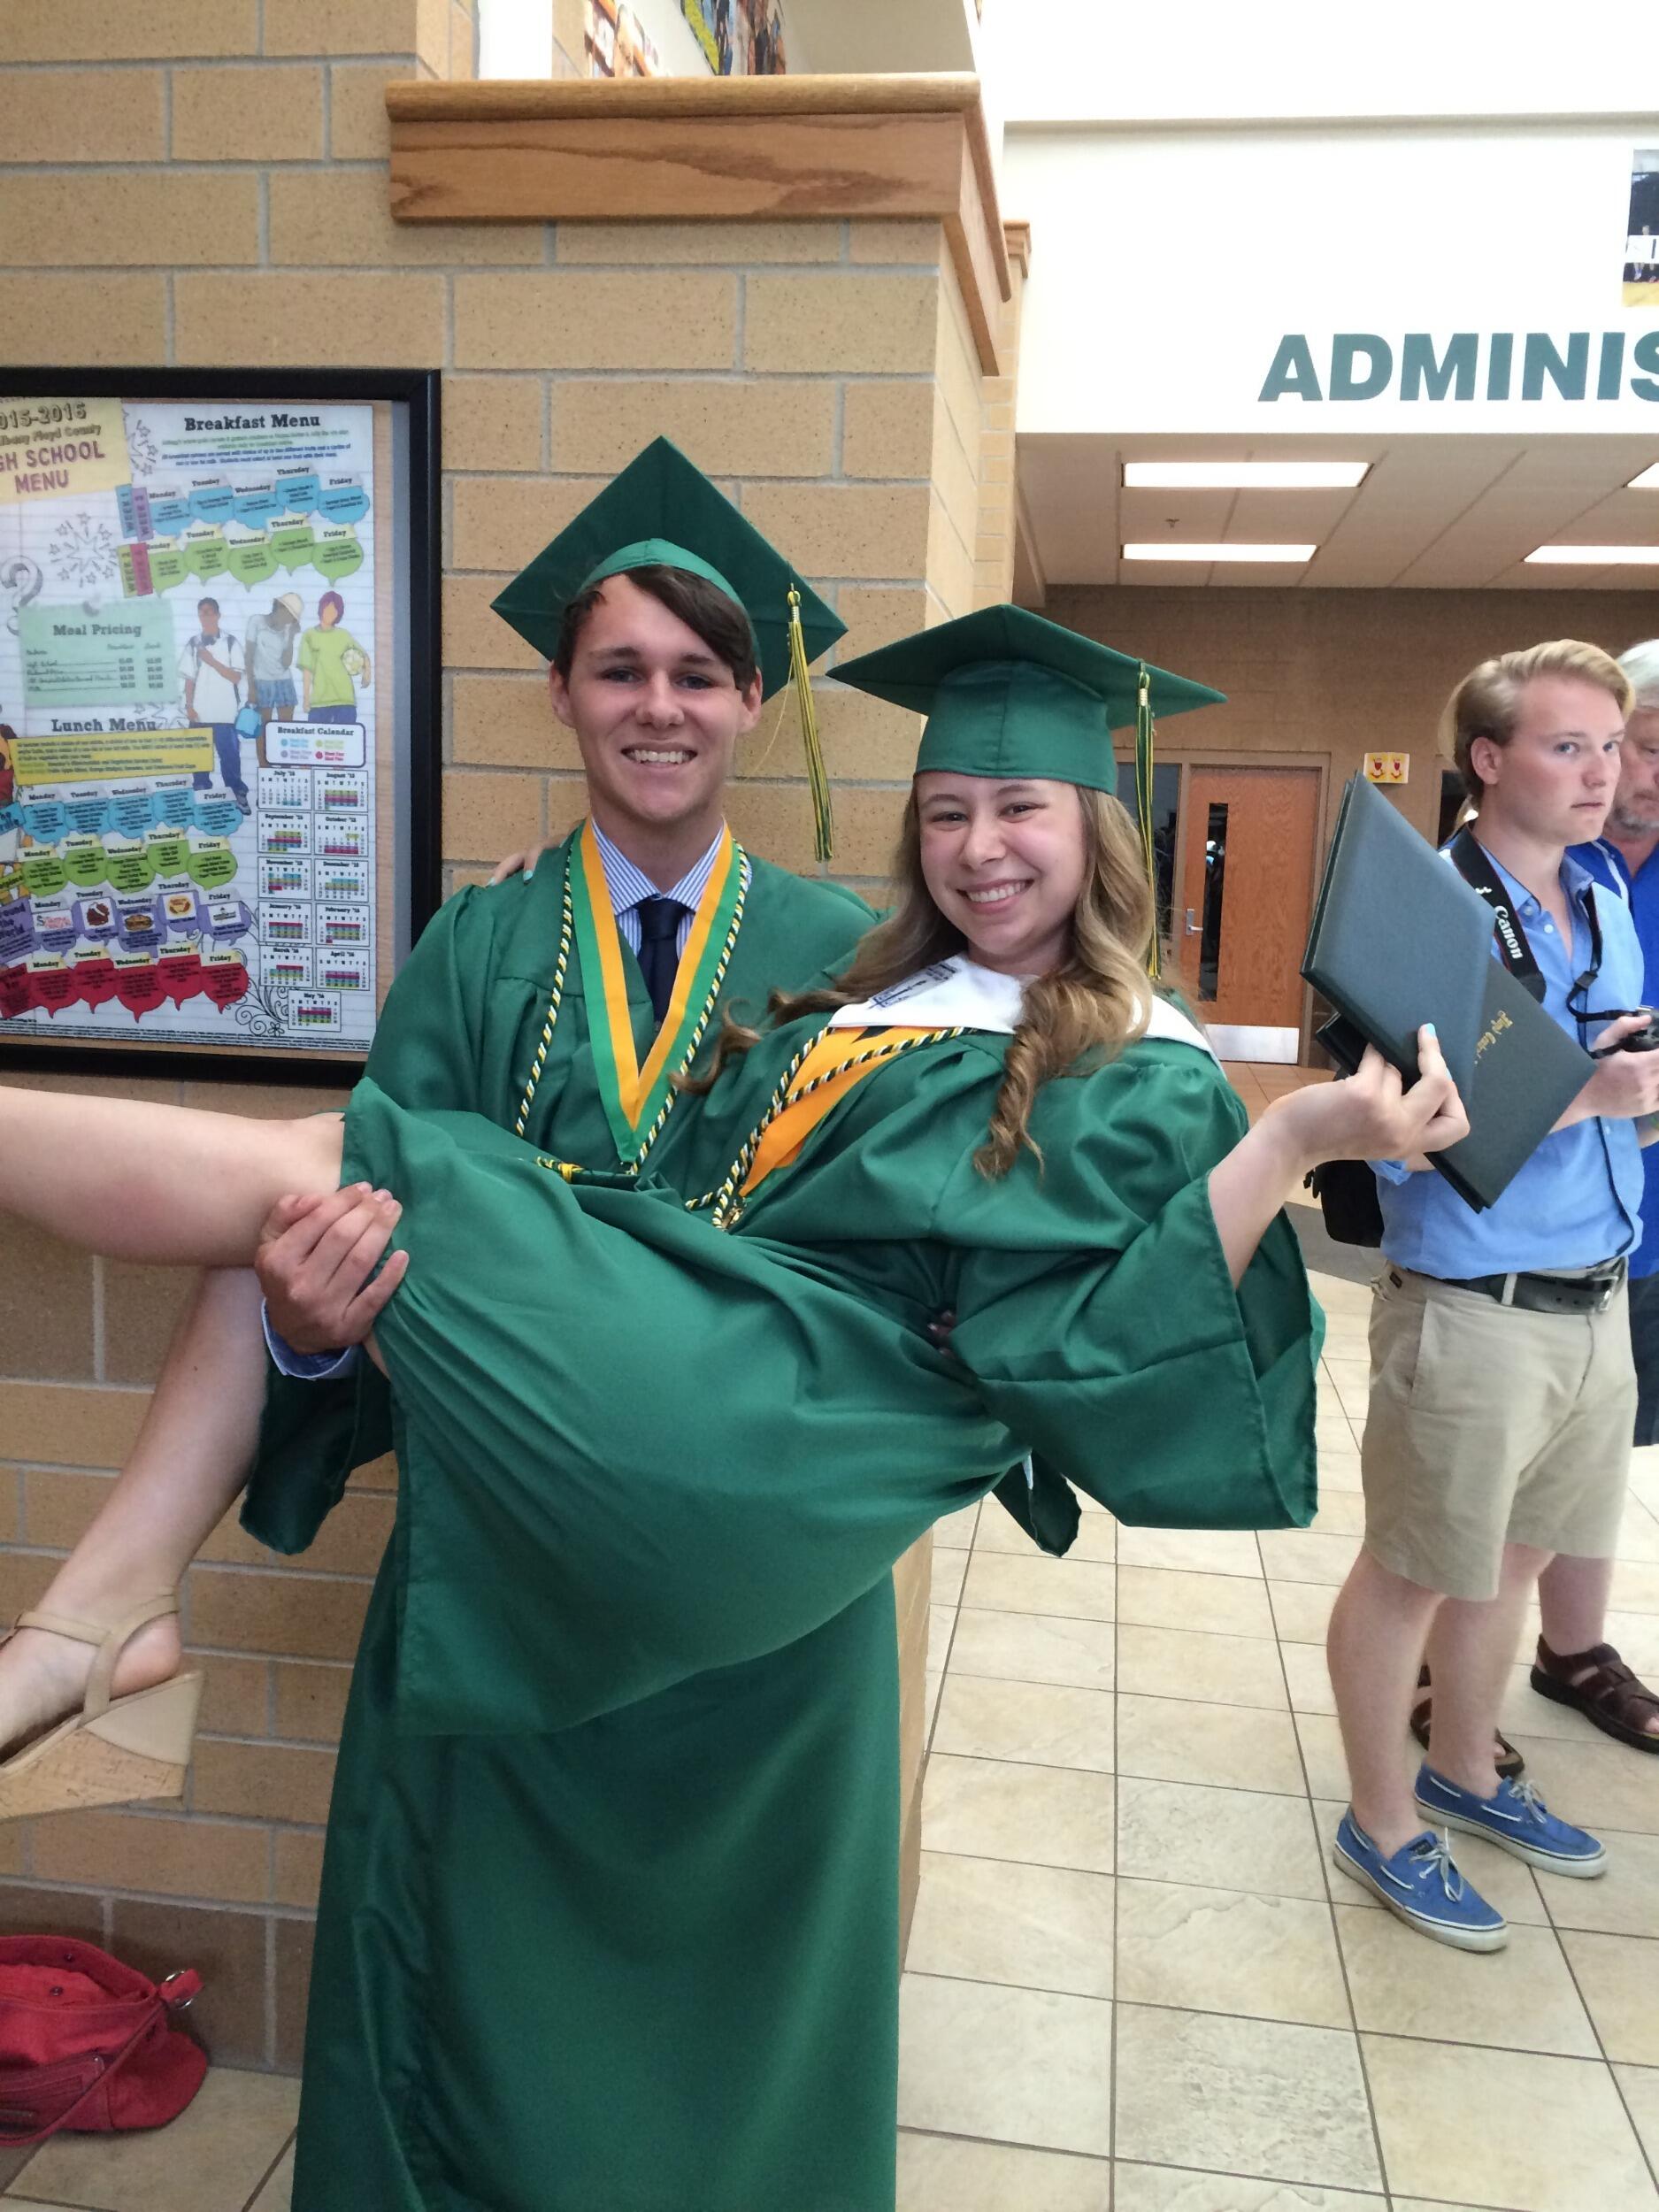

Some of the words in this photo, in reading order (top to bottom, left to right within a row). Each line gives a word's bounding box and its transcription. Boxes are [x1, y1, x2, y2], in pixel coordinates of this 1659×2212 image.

[184, 414, 265, 432] Breakfast
[271, 413, 320, 428] Menu
[26, 441, 105, 468] SCHOOL
[277, 465, 310, 475] Thursday
[15, 469, 69, 495] MENU
[191, 477, 220, 487] Tuesday
[329, 477, 353, 486] Friday
[234, 483, 272, 494] Wednesday
[149, 489, 177, 499] Monday
[271, 518, 305, 528] Thursday
[186, 529, 215, 539] Tuesday
[323, 528, 347, 538] Friday
[229, 535, 266, 546] Wednesday
[53, 624, 87, 636] Meal
[92, 624, 142, 637] Pricing
[51, 718, 104, 732] Lunch
[109, 718, 157, 731] Menu
[28, 792, 55, 801] Monday
[111, 787, 147, 796] Wednesday
[148, 831, 180, 840] Thursday
[65, 839, 93, 848] Tuesday
[24, 849, 50, 858] Monday
[107, 845, 143, 855] Wednesday
[158, 881, 189, 890] Thursday
[1494, 905, 1524, 960] Canon
[74, 950, 102, 959] Tuesday
[160, 946, 191, 955] Thursday
[33, 960, 60, 969] Monday
[116, 957, 151, 966] Wednesday
